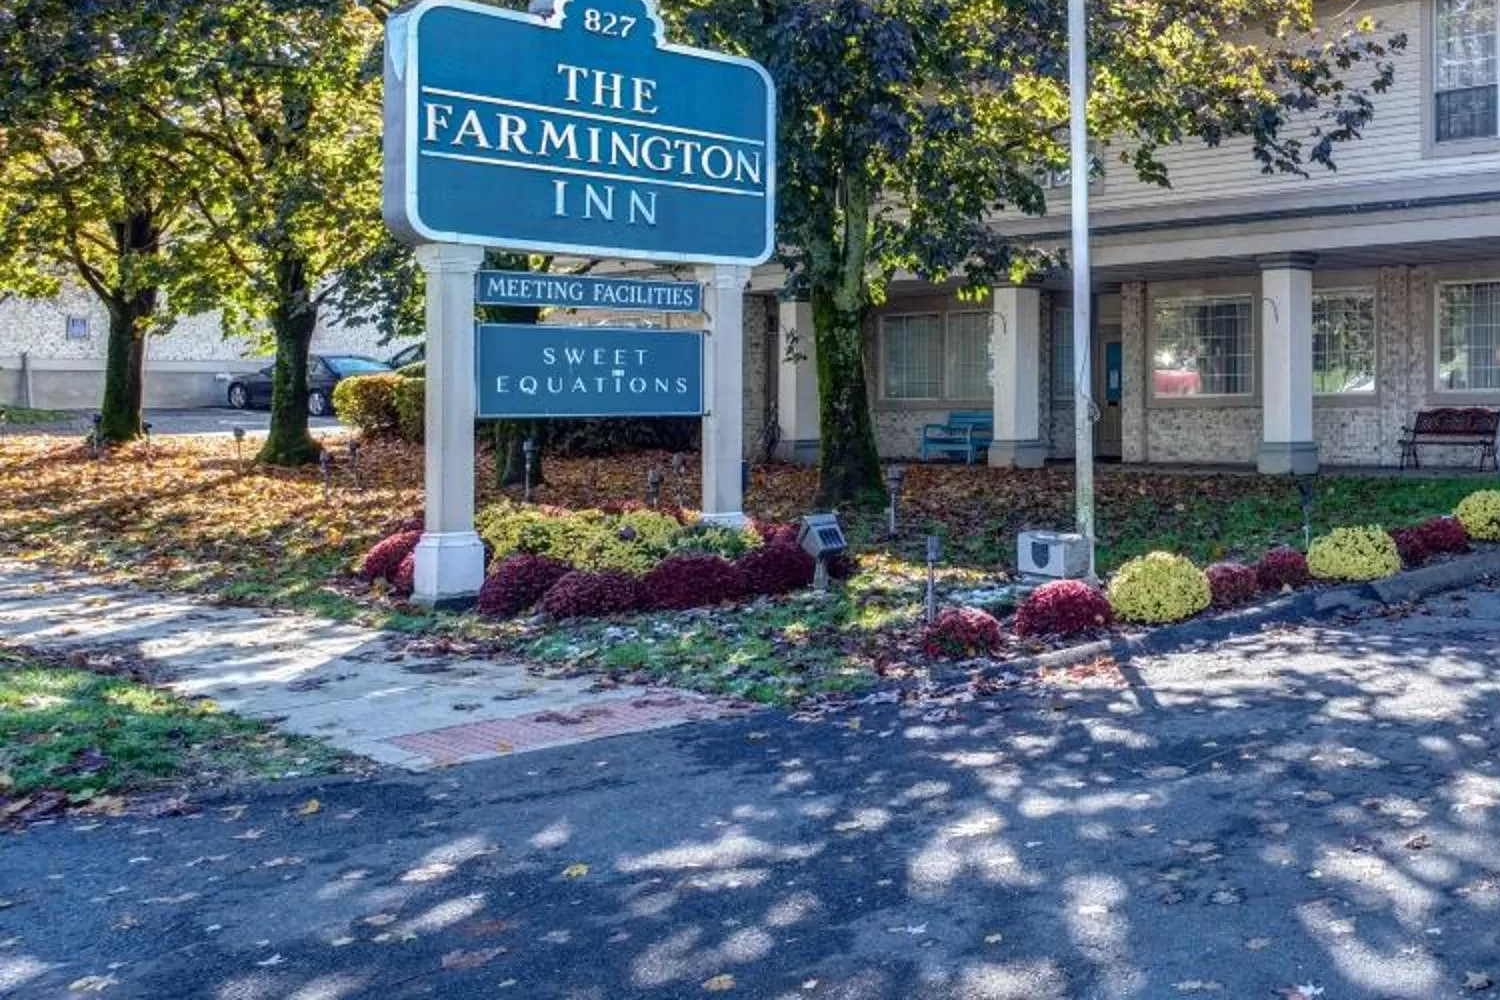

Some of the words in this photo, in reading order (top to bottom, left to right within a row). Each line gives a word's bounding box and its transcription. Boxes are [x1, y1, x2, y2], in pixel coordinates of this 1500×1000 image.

[584, 9, 636, 37] 827
[557, 63, 658, 114] THE
[424, 103, 761, 184] FARMINGTON
[552, 179, 657, 226] INN
[487, 278, 583, 301] MEETING
[593, 284, 693, 306] FACILITIES
[543, 348, 649, 365] SWEET
[496, 370, 688, 395] EQUATIONS
